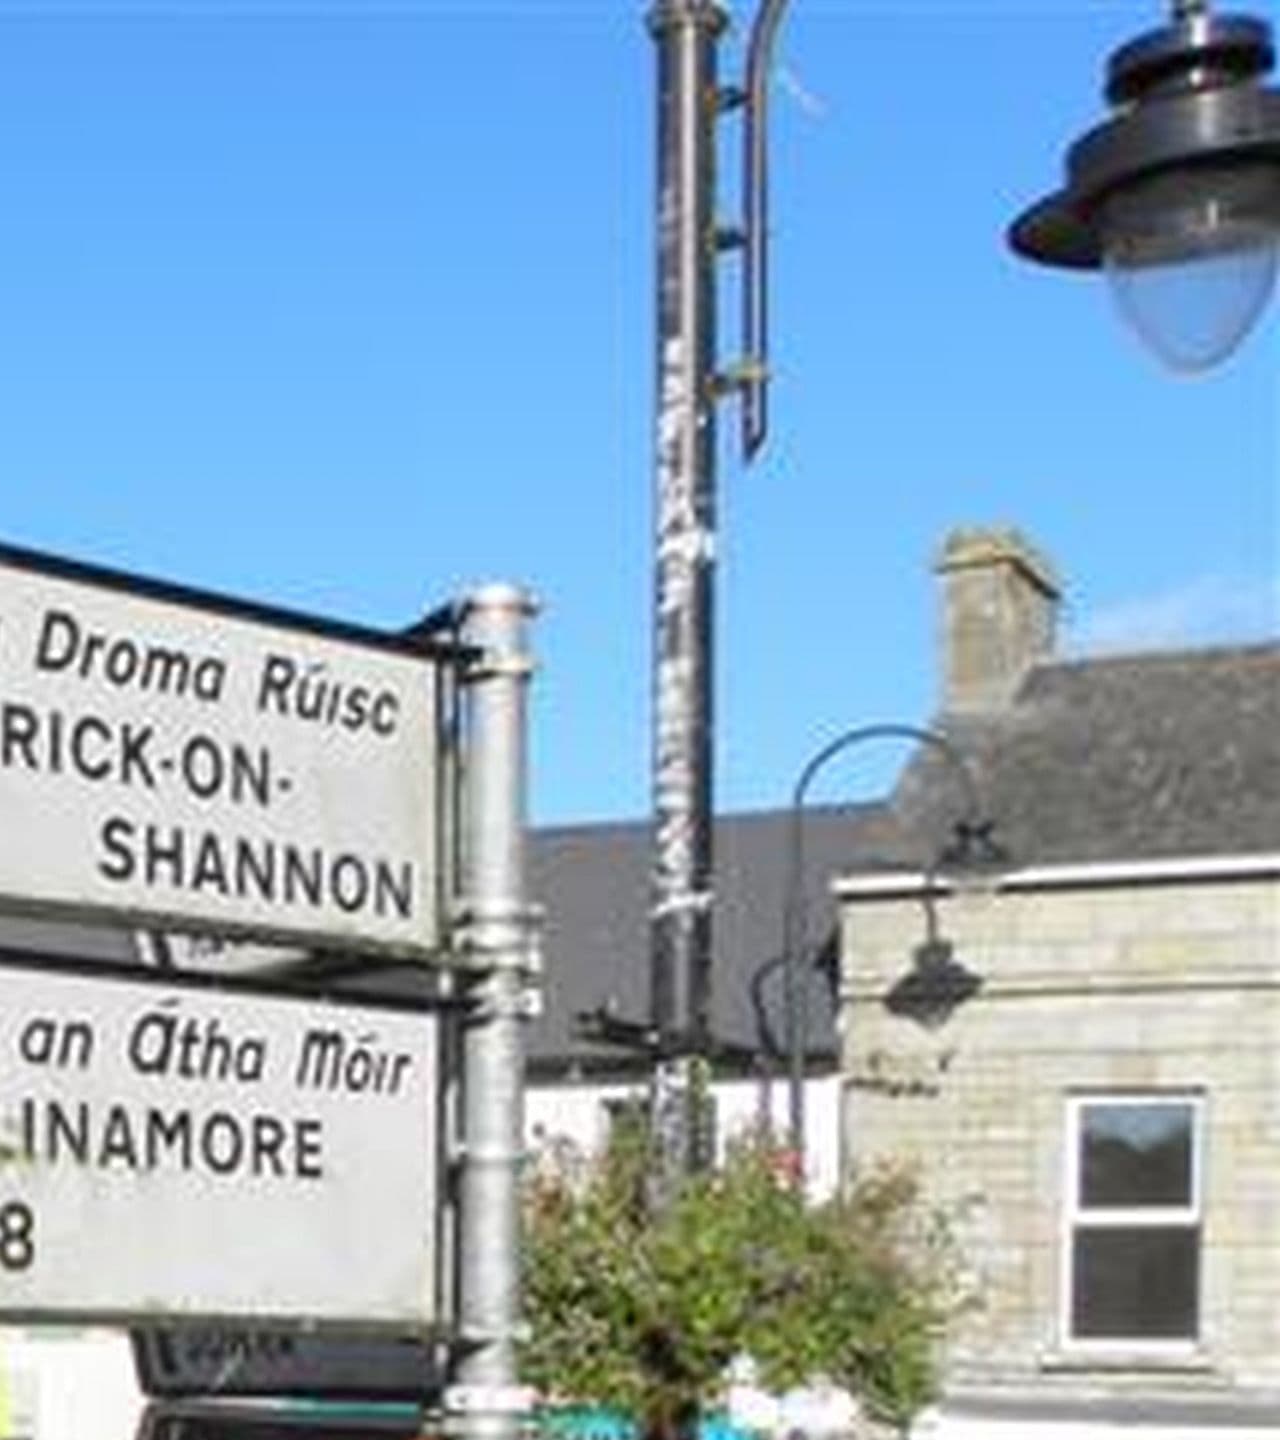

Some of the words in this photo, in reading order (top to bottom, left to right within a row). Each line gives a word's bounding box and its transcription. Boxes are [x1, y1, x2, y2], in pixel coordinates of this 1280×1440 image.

[36, 610, 226, 702] Droma
[258, 654, 398, 735] Rúisc
[99, 817, 415, 918] SHANNON
[20, 1019, 94, 1066] an
[128, 998, 265, 1082] Átha
[296, 1030, 413, 1094] Móir
